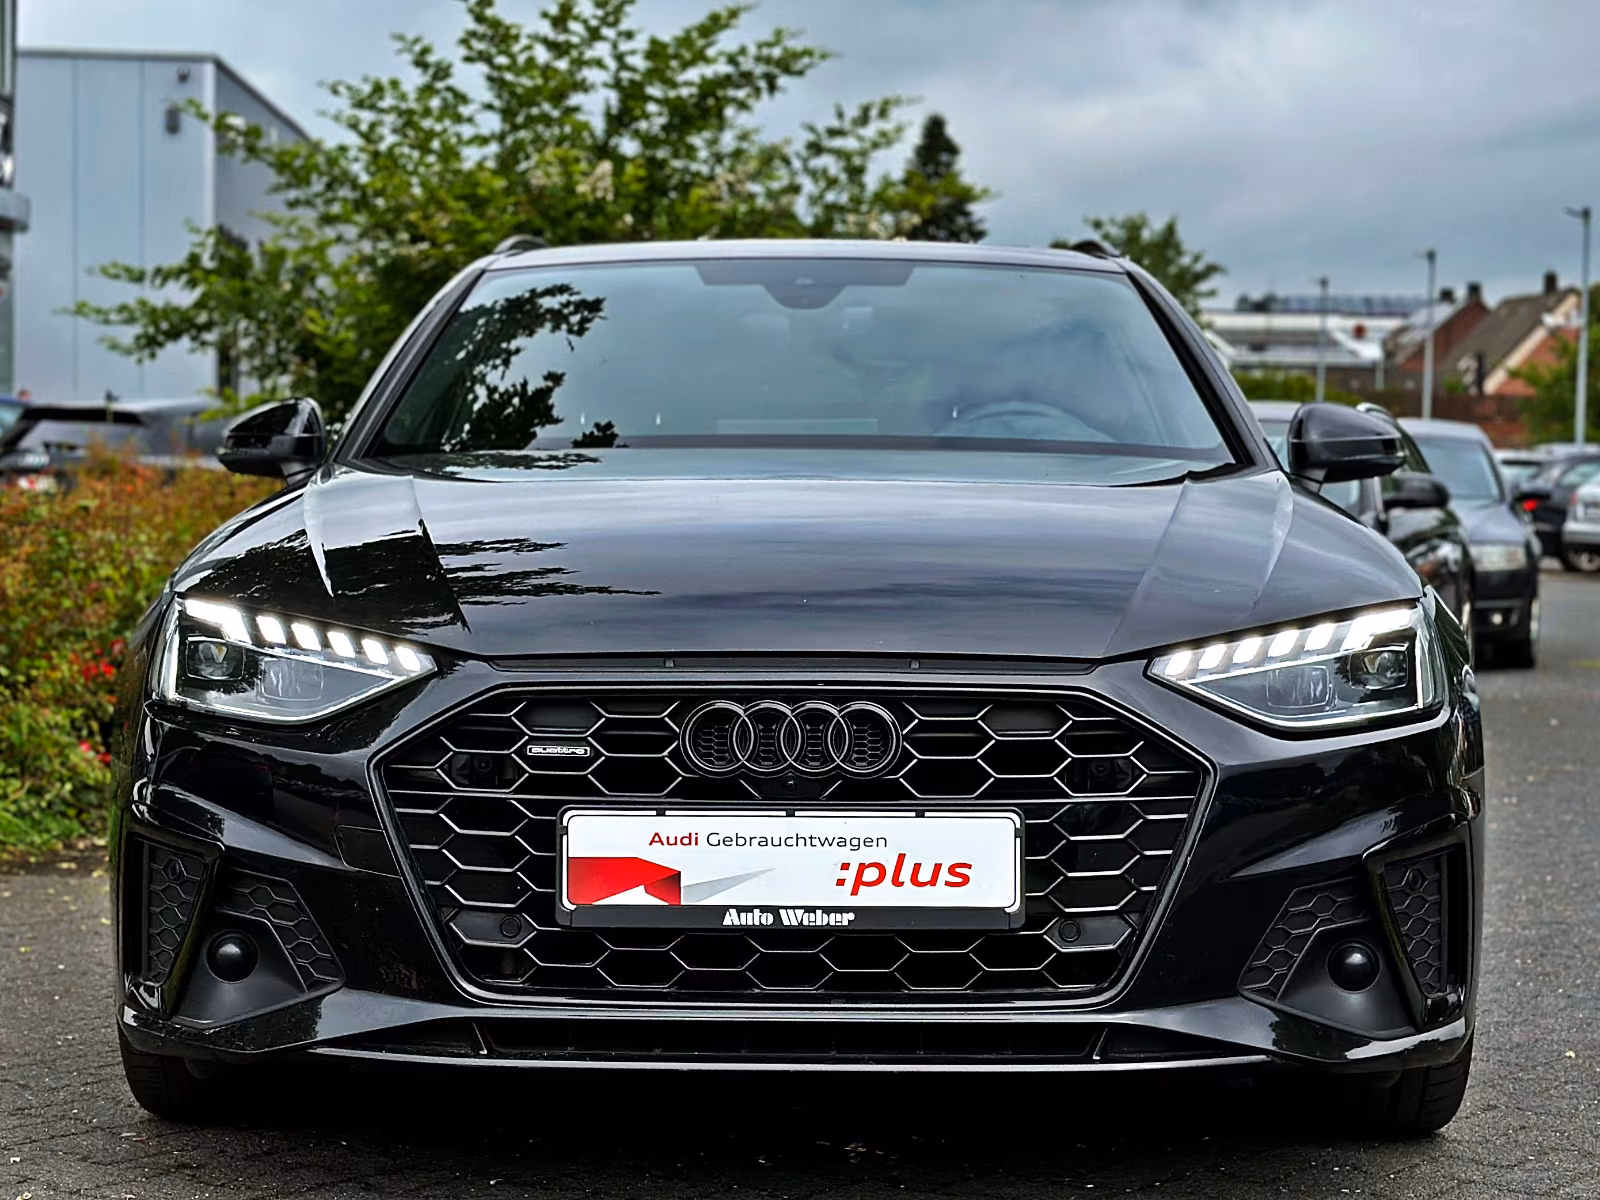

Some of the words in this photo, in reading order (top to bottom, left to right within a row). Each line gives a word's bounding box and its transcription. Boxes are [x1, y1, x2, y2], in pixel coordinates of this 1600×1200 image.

[531, 746, 586, 755] quattro
[648, 832, 699, 847] Audi
[706, 832, 888, 852] Gebrauchtwagen
[835, 852, 973, 897] :plus
[722, 908, 774, 926] Auto
[778, 908, 856, 926] Weber
